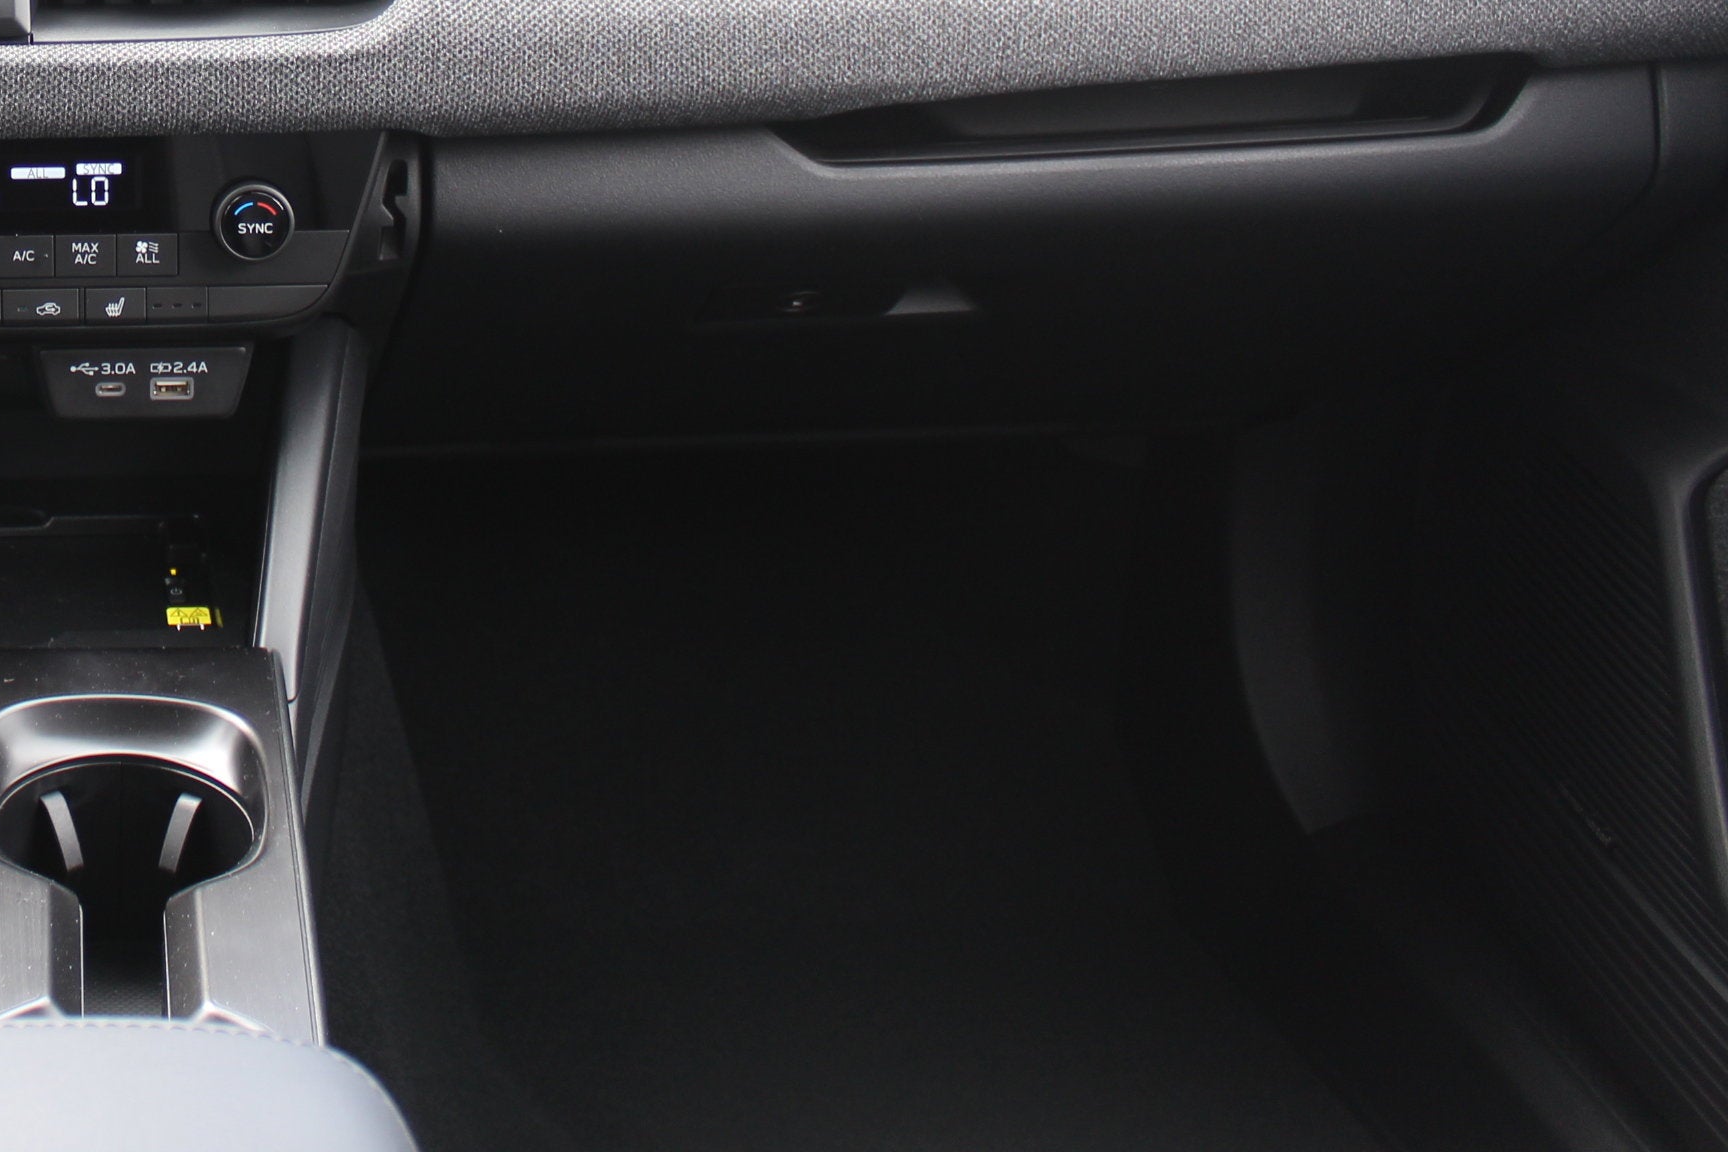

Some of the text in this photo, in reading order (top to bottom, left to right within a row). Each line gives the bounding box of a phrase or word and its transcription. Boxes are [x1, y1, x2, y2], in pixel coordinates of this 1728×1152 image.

[27, 167, 49, 179] ALL
[83, 163, 115, 175] SYNC
[237, 222, 273, 235] SYNC
[72, 242, 99, 254] MAX
[13, 249, 35, 263] A/C
[74, 253, 97, 266] A/C
[135, 253, 160, 264] ALL
[101, 362, 136, 375] 3.0A
[173, 361, 208, 374] 2.4A
